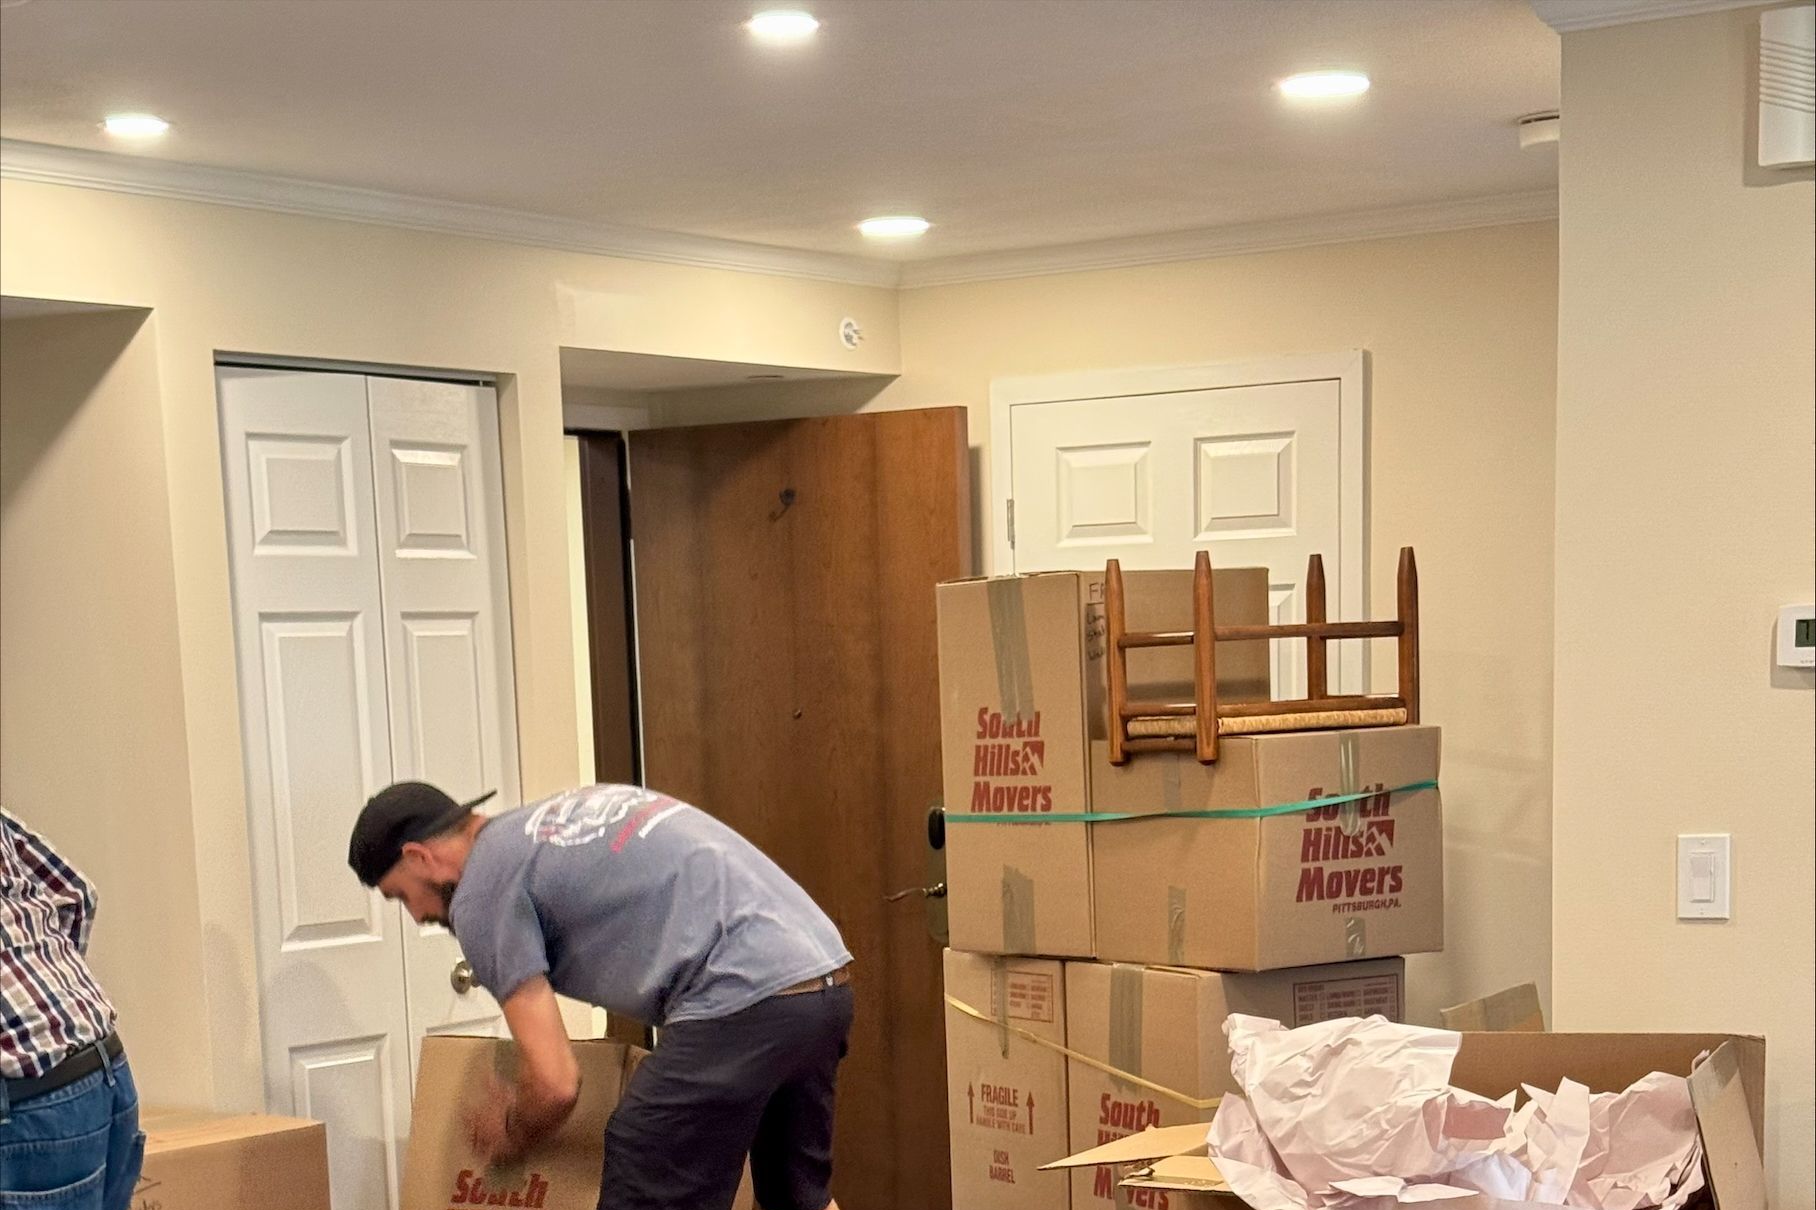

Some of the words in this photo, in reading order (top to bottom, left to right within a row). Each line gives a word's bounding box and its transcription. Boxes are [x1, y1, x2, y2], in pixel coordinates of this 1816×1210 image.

[973, 743, 1020, 777] Hills
[970, 781, 1052, 813] Movers
[1300, 826, 1365, 863] Hills
[1296, 865, 1403, 903] Movers
[981, 1083, 1019, 1108] FRAGILE
[1099, 1092, 1160, 1131] South
